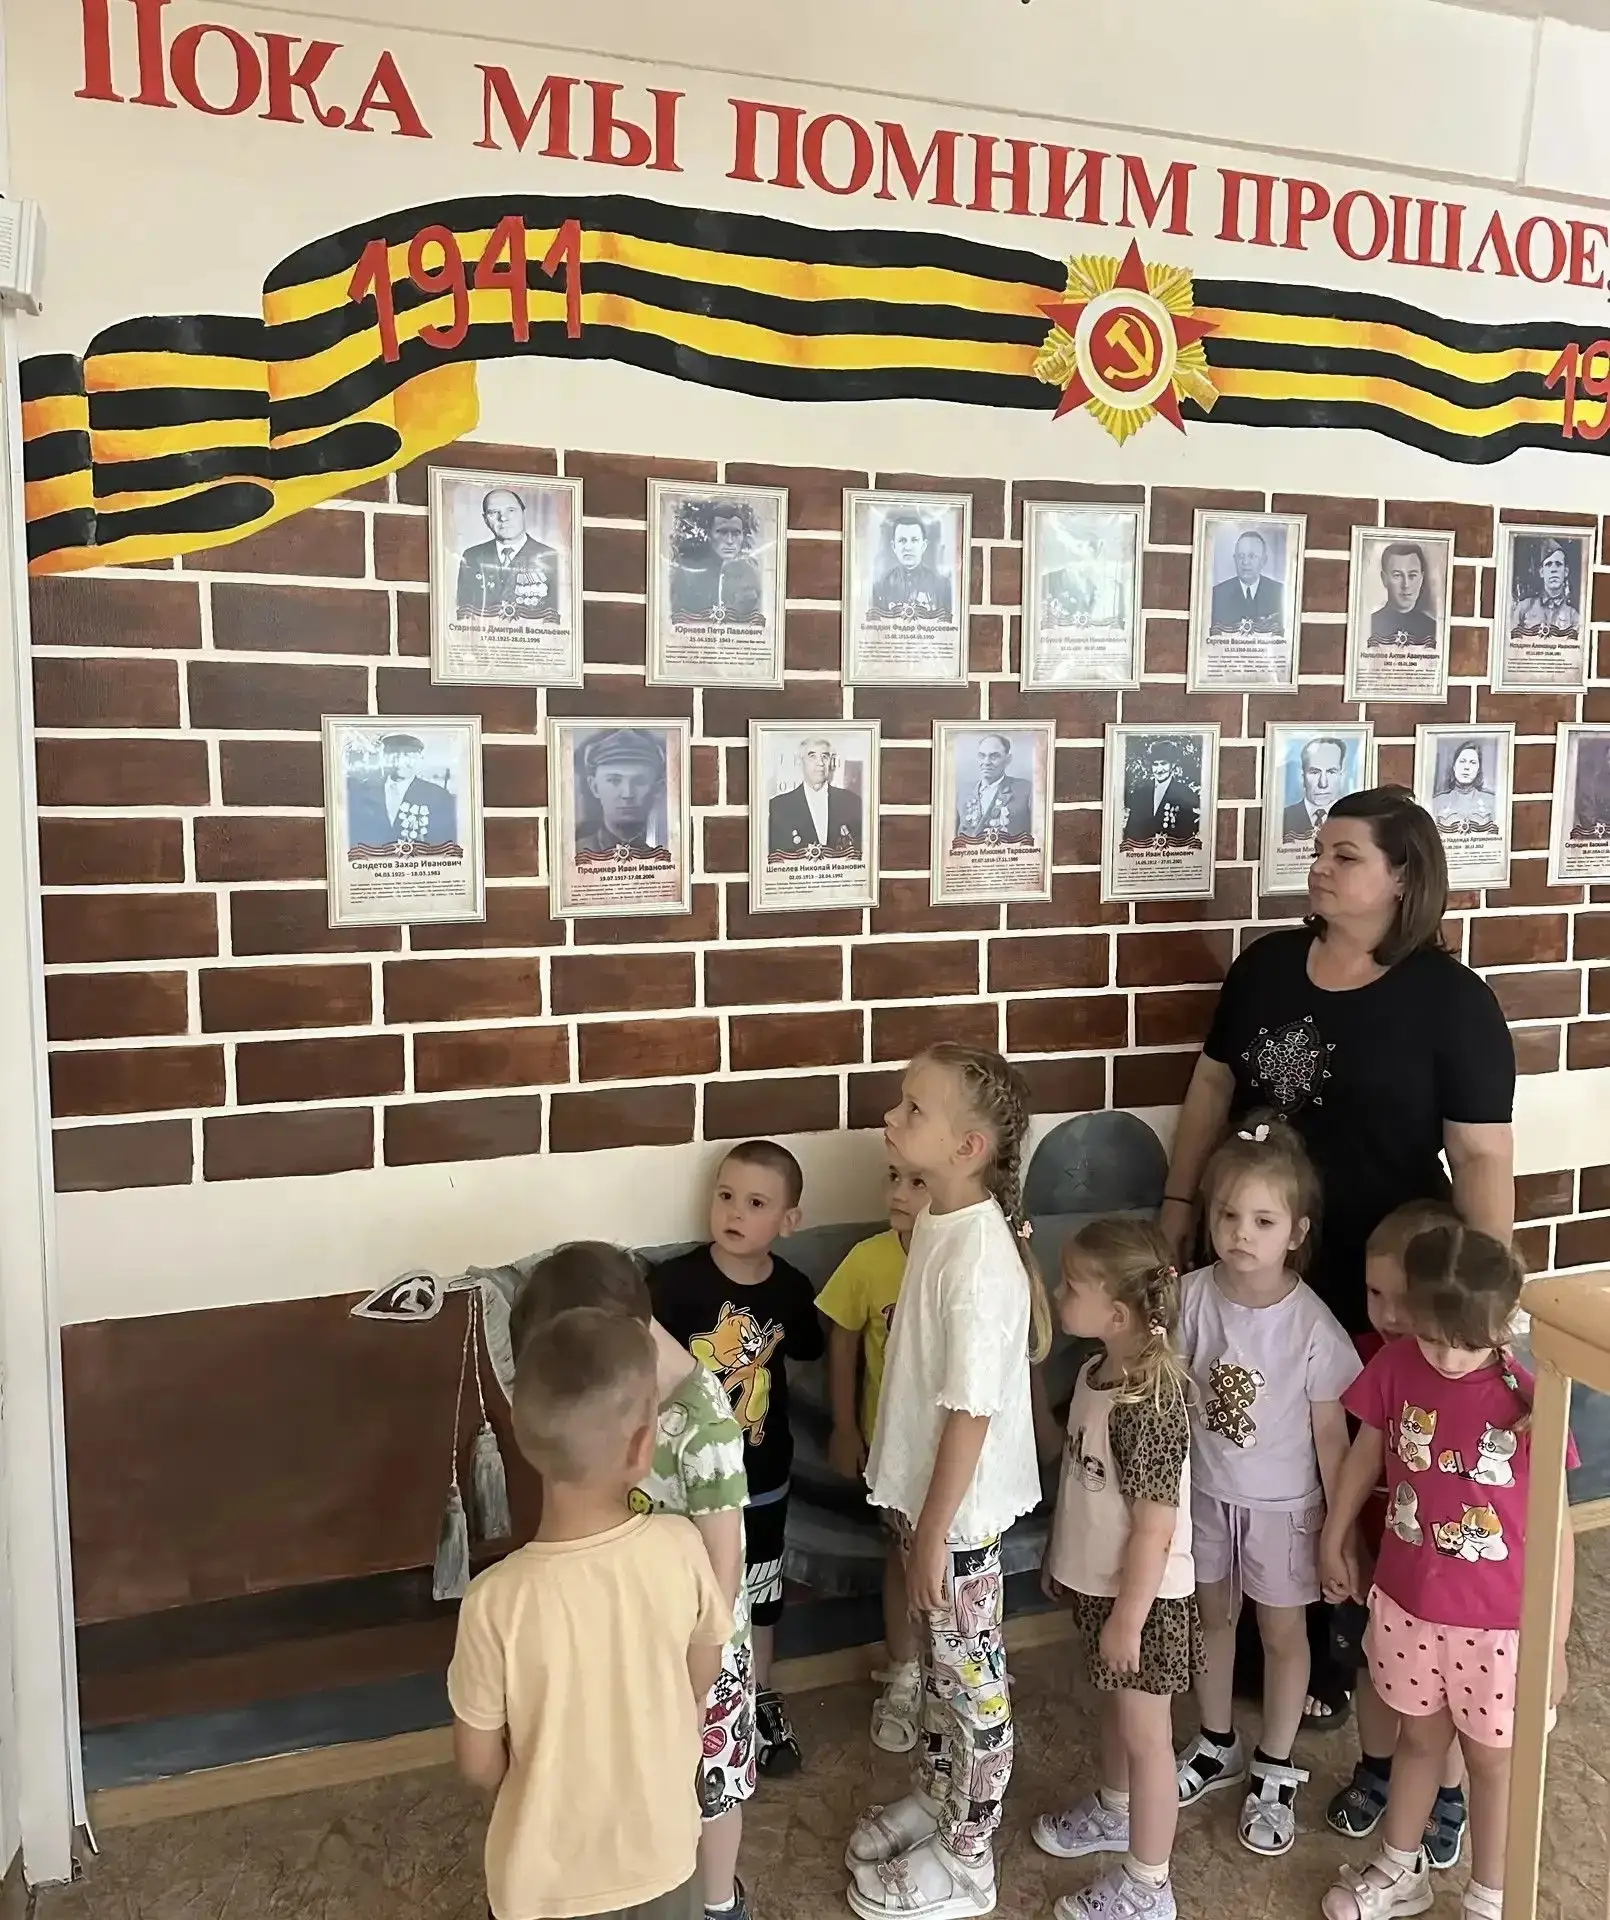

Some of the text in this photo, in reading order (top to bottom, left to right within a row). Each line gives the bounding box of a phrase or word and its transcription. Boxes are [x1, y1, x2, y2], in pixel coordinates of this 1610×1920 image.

[74, 0, 1610, 298] ПОКА МЫ ПОМНИМ ПРОШЛОЕ
[348, 215, 583, 363] 1941
[487, 624, 524, 634] Дмитрий
[525, 626, 570, 636] Васильевич
[707, 626, 725, 636] Петр
[726, 627, 763, 636] Павлович
[1007, 847, 1041, 855] Тарасович
[1162, 850, 1194, 858] Ефимович
[352, 859, 462, 870] Сандетов Захар Иванович
[617, 865, 637, 873] Иван
[638, 864, 675, 872] Иванович
[766, 865, 798, 873] Шепелев
[799, 863, 831, 871] Николай
